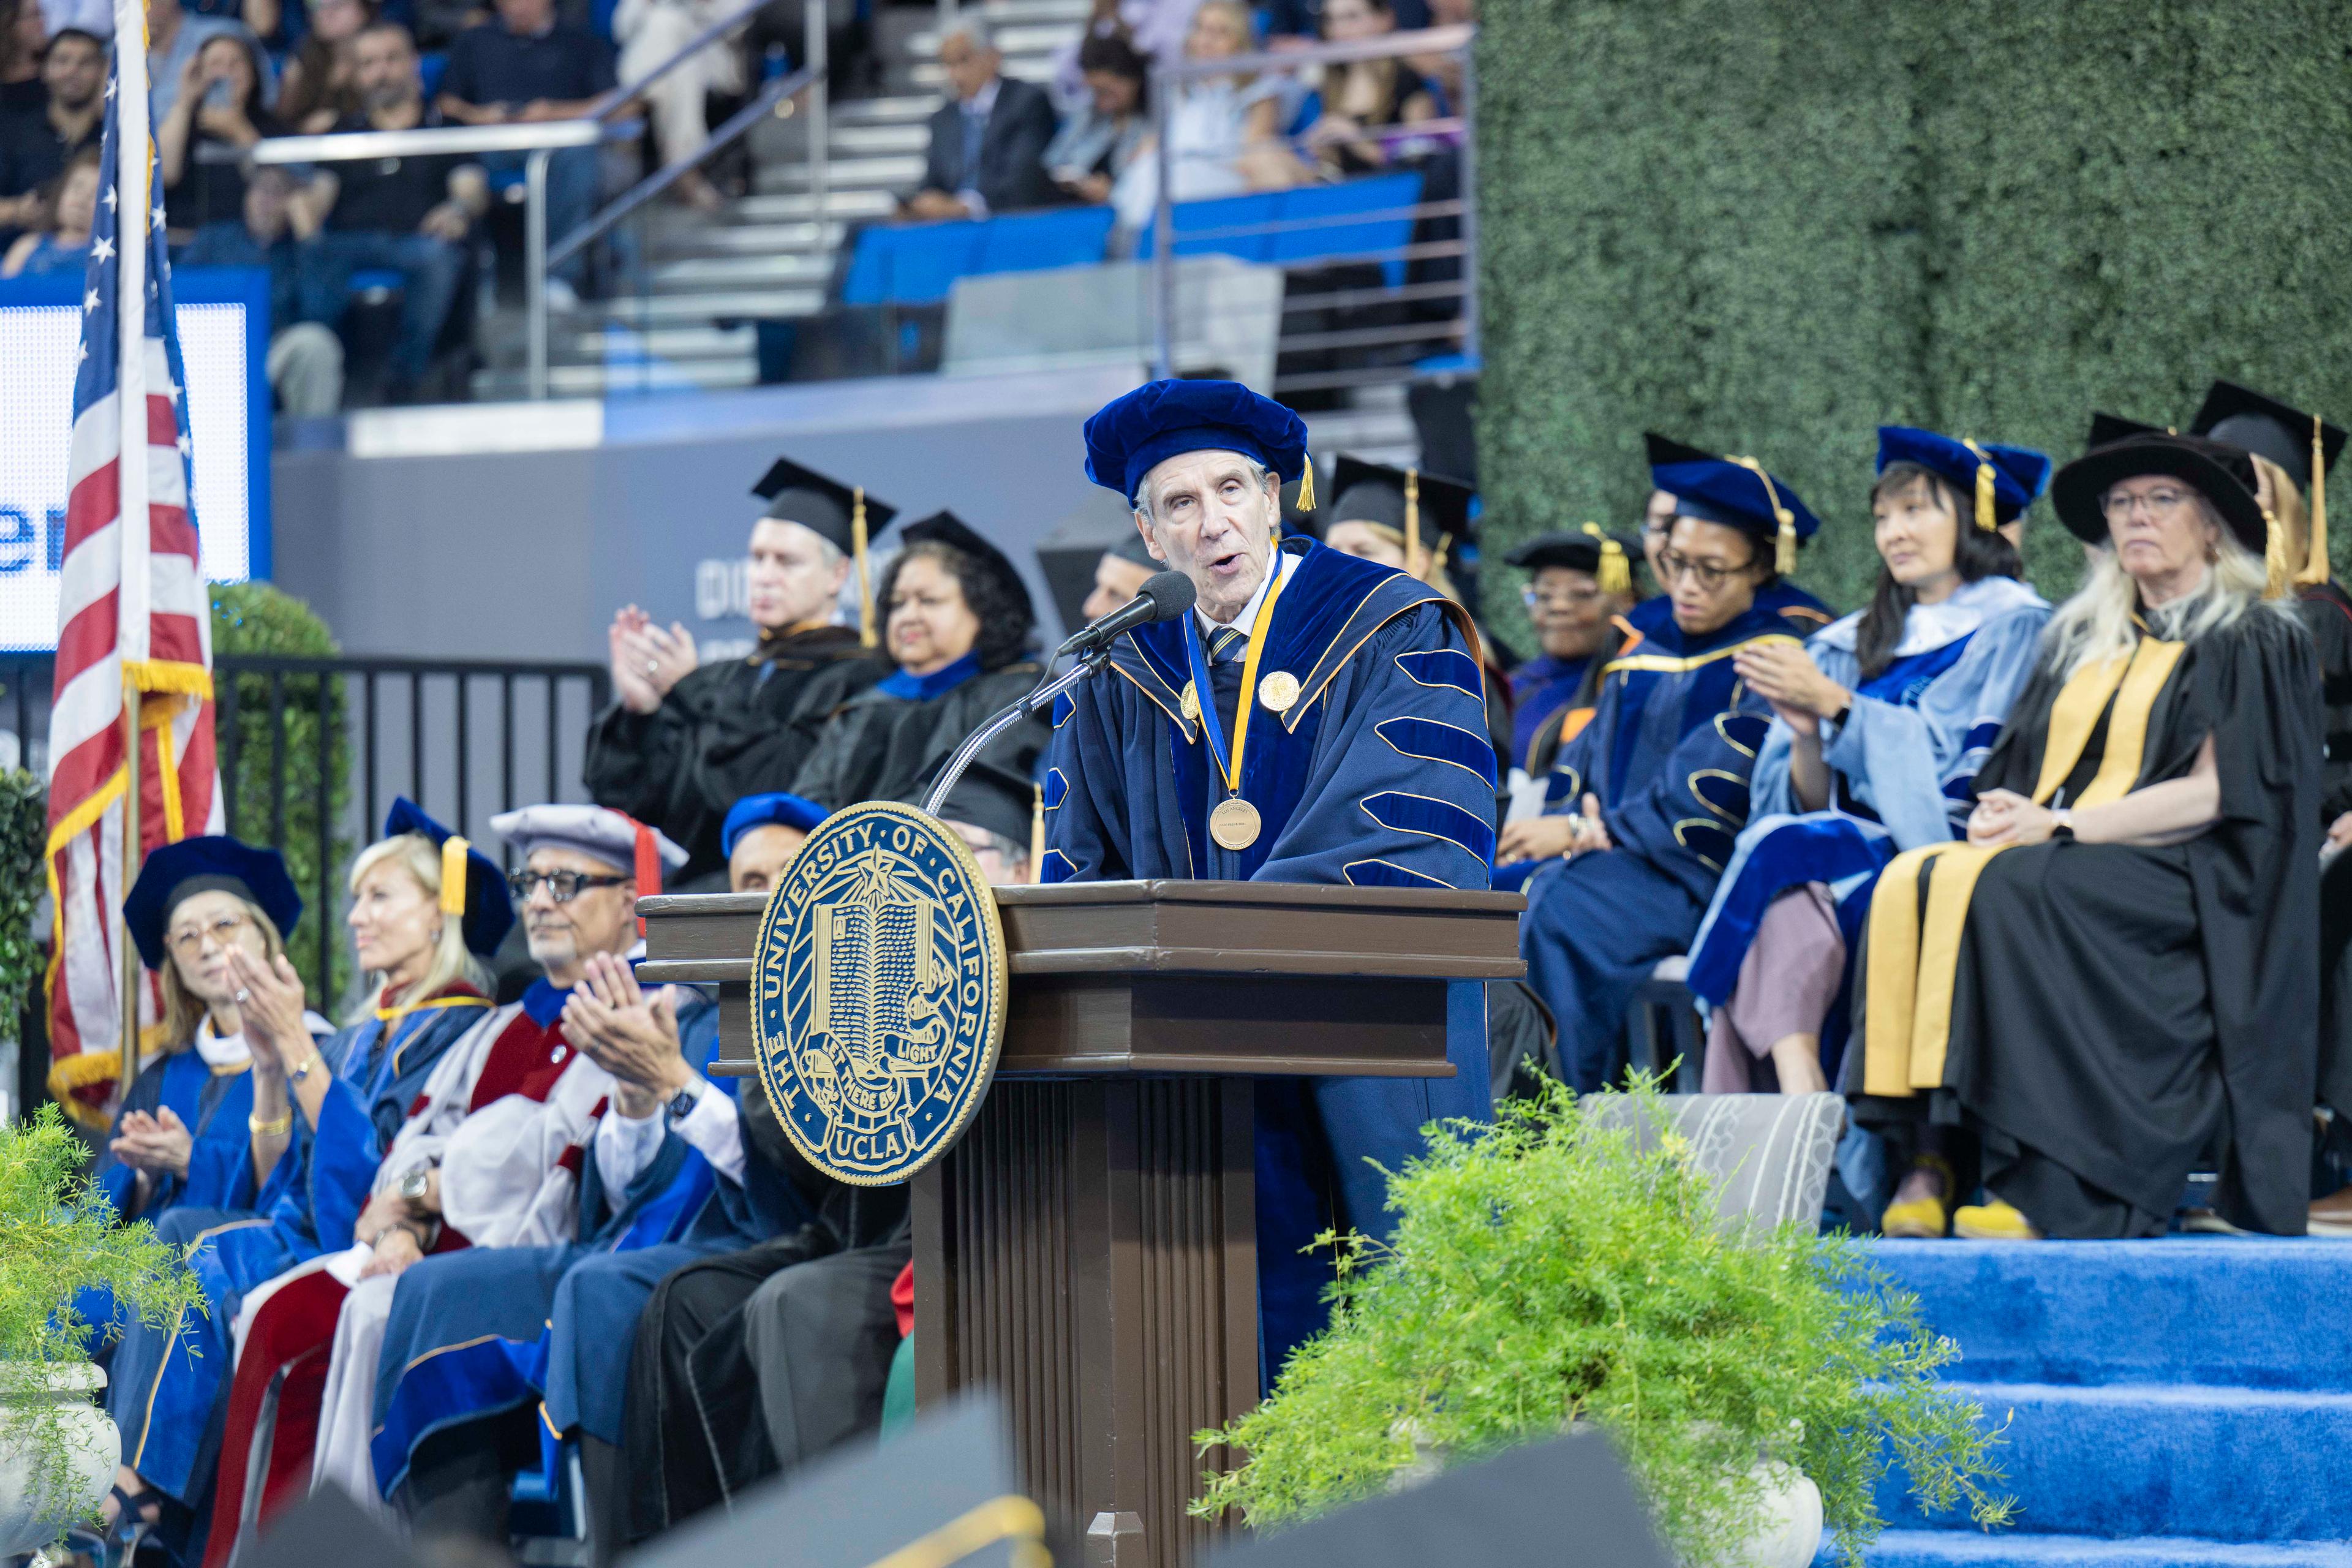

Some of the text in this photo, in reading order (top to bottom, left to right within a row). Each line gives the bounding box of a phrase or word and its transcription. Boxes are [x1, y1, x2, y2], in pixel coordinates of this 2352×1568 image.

[765, 822, 980, 1110] THE UNIVERSITY OF CALIFORNIA
[822, 1034, 938, 1110] LET THERE BE LIGHT
[836, 1130, 903, 1160] UCLA
